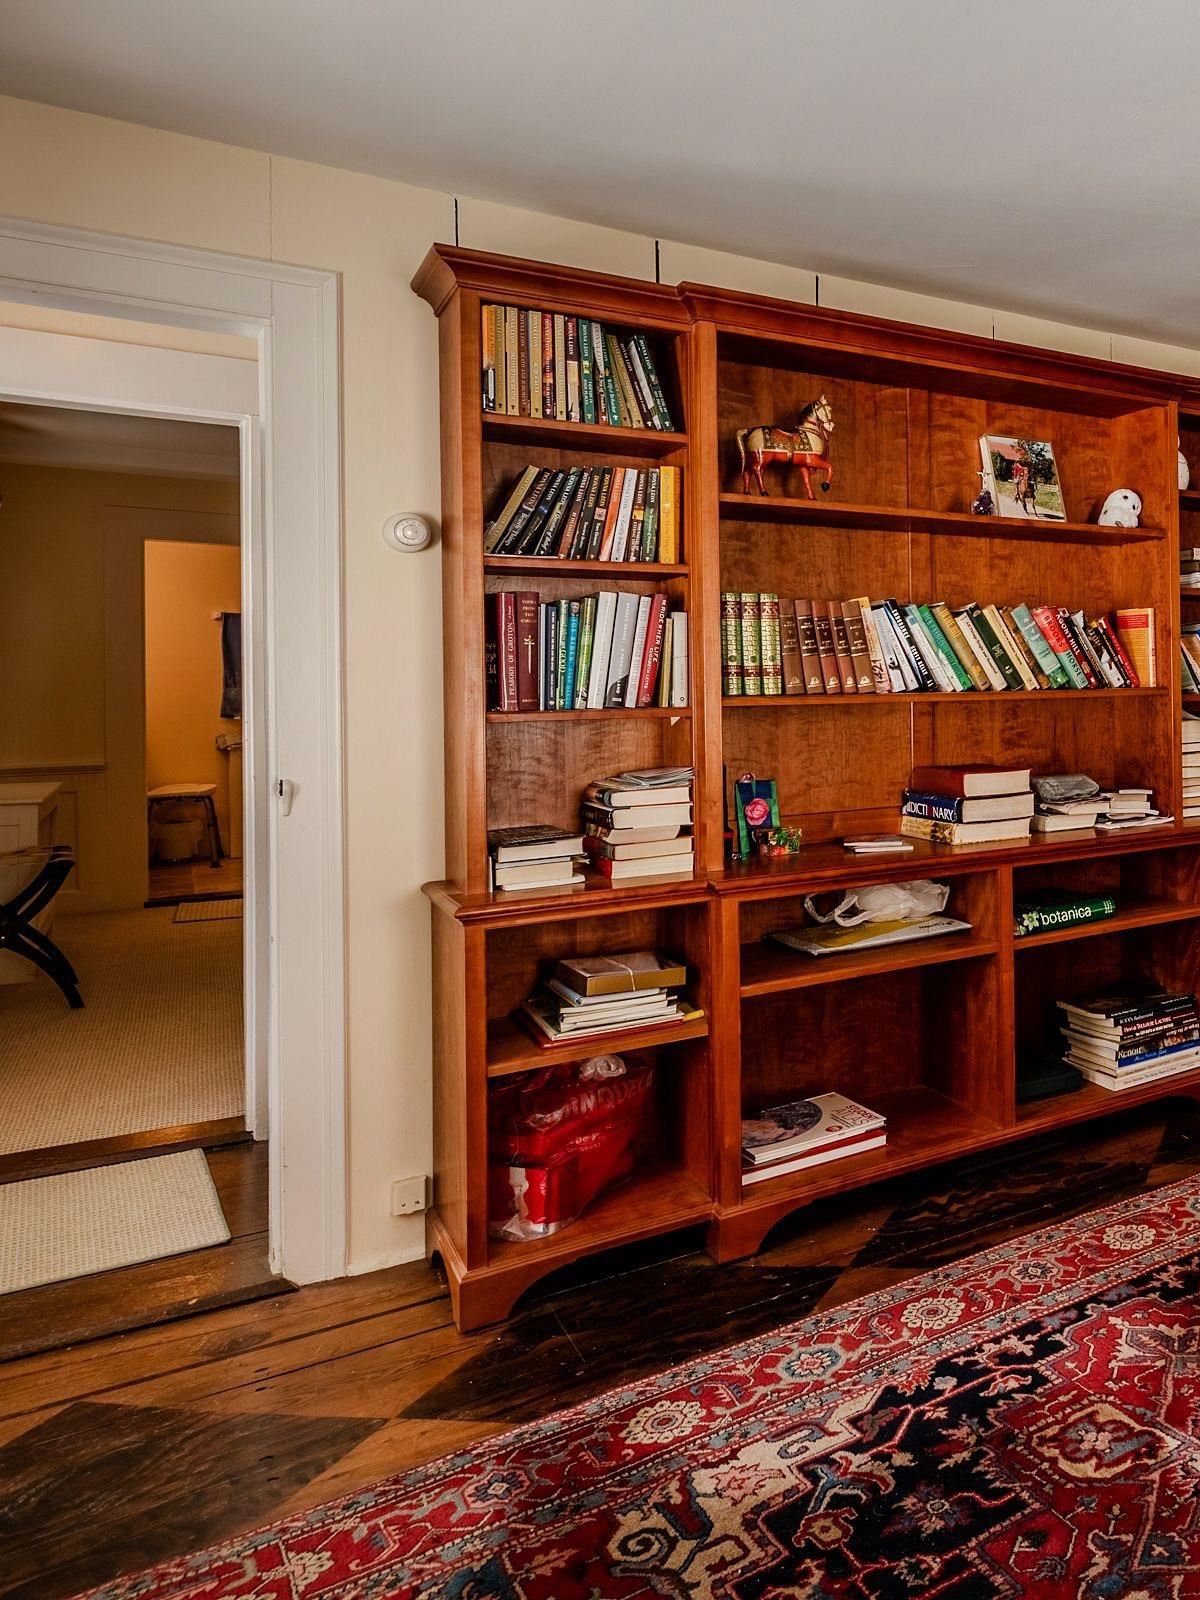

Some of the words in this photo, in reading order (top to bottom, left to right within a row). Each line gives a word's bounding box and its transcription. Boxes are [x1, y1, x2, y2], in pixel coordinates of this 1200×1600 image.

[639, 340, 647, 355] DONNA
[536, 472, 549, 490] DONNA
[553, 473, 564, 488] DONNA
[565, 475, 576, 492] DONNA
[580, 472, 588, 487] DONNA
[591, 475, 599, 492] DONNA
[602, 474, 610, 491] DONNA
[527, 491, 539, 506] LEON
[546, 488, 556, 501] LEON
[558, 492, 568, 505] LEON
[576, 488, 584, 502] LEON
[513, 513, 528, 528] Beastly
[658, 606, 666, 623] RIDE
[892, 609, 910, 638] ENDURANCE
[1044, 615, 1064, 648] BROOKS
[1056, 614, 1071, 638] AGONY
[1069, 639, 1080, 655] HILL
[508, 653, 514, 663] OF
[910, 645, 920, 660] SCOTT
[916, 660, 928, 675] KELLY
[1066, 652, 1081, 677] HORSE
[910, 801, 953, 820] DICTINARY
[1040, 906, 1092, 925] botanica
[831, 1109, 868, 1125] ATLAS
[846, 1105, 879, 1120] STUDENT
